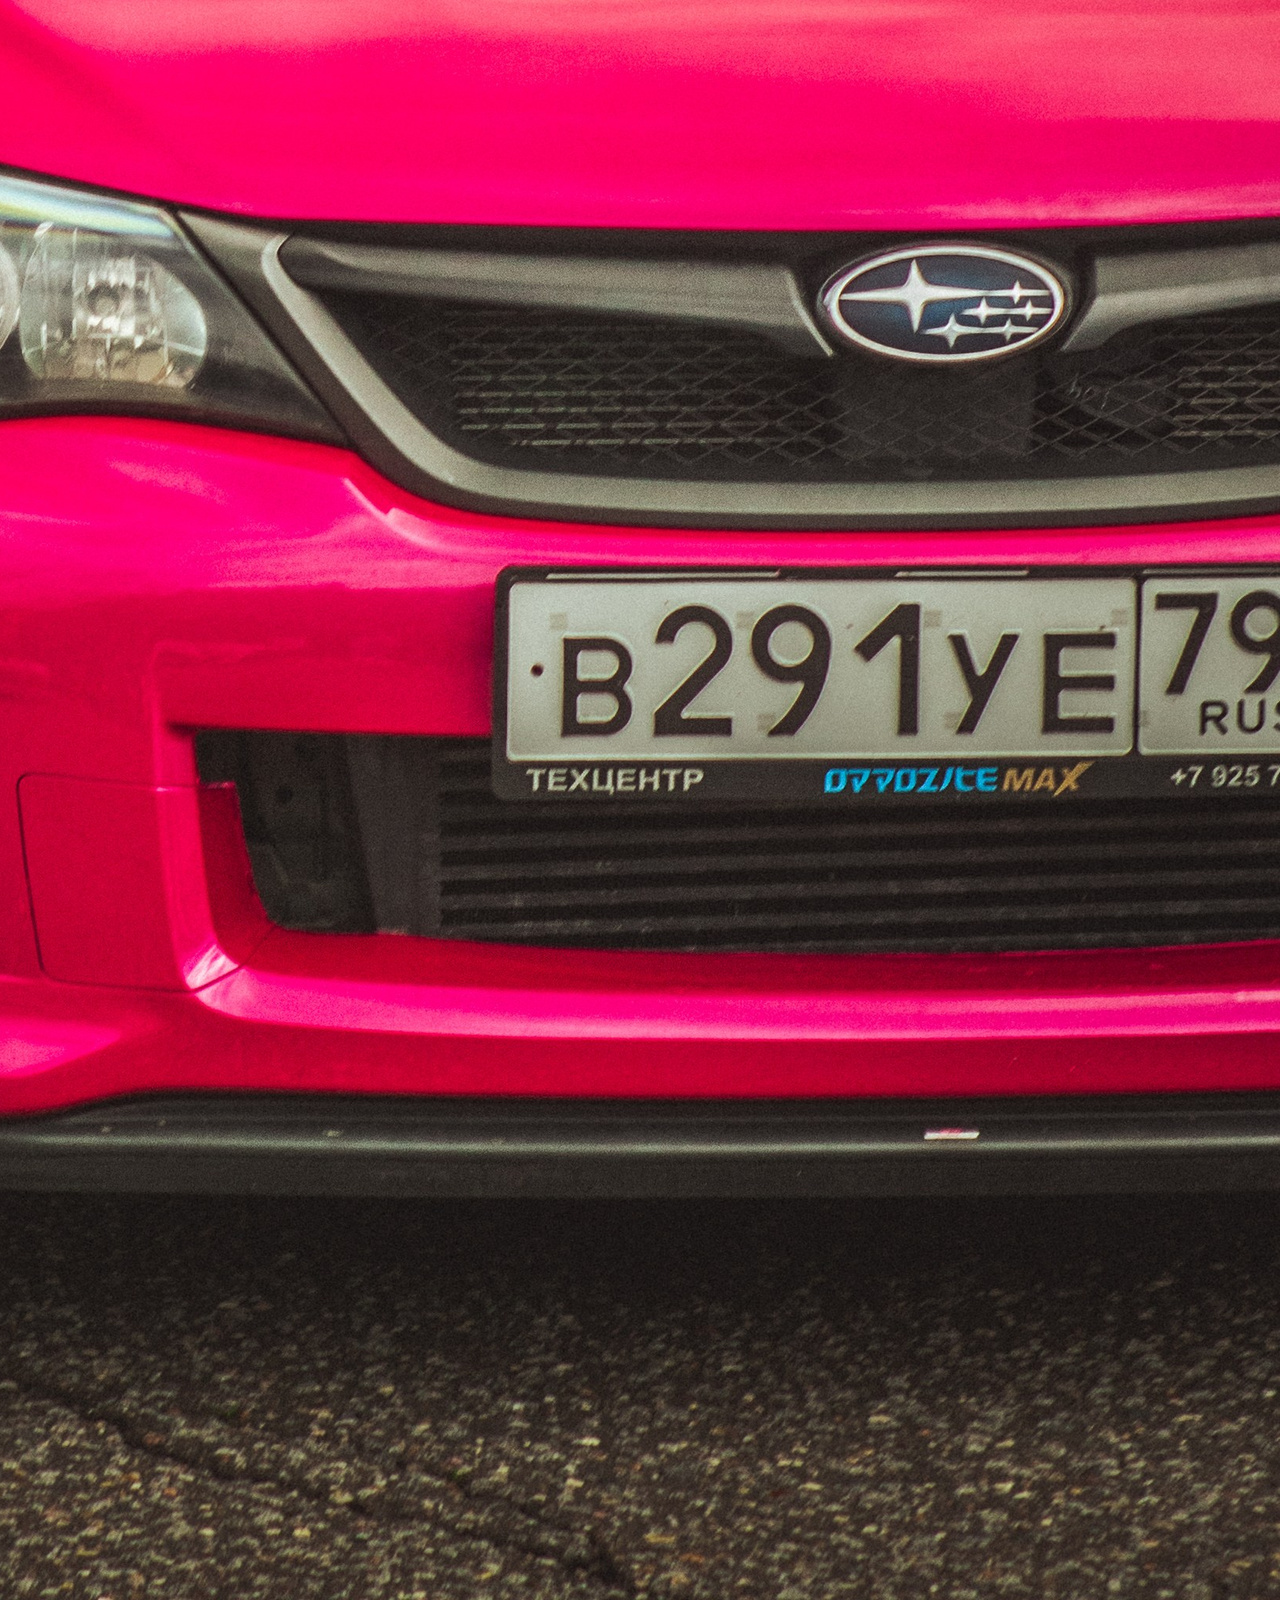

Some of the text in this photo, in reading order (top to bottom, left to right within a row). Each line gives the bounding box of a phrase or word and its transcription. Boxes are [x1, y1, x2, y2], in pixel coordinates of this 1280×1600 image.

[526, 768, 705, 795] ТЕХЦЕНТР
[1001, 749, 1096, 798] MAX
[1170, 764, 1204, 788] +7
[1211, 764, 1261, 788] 925
